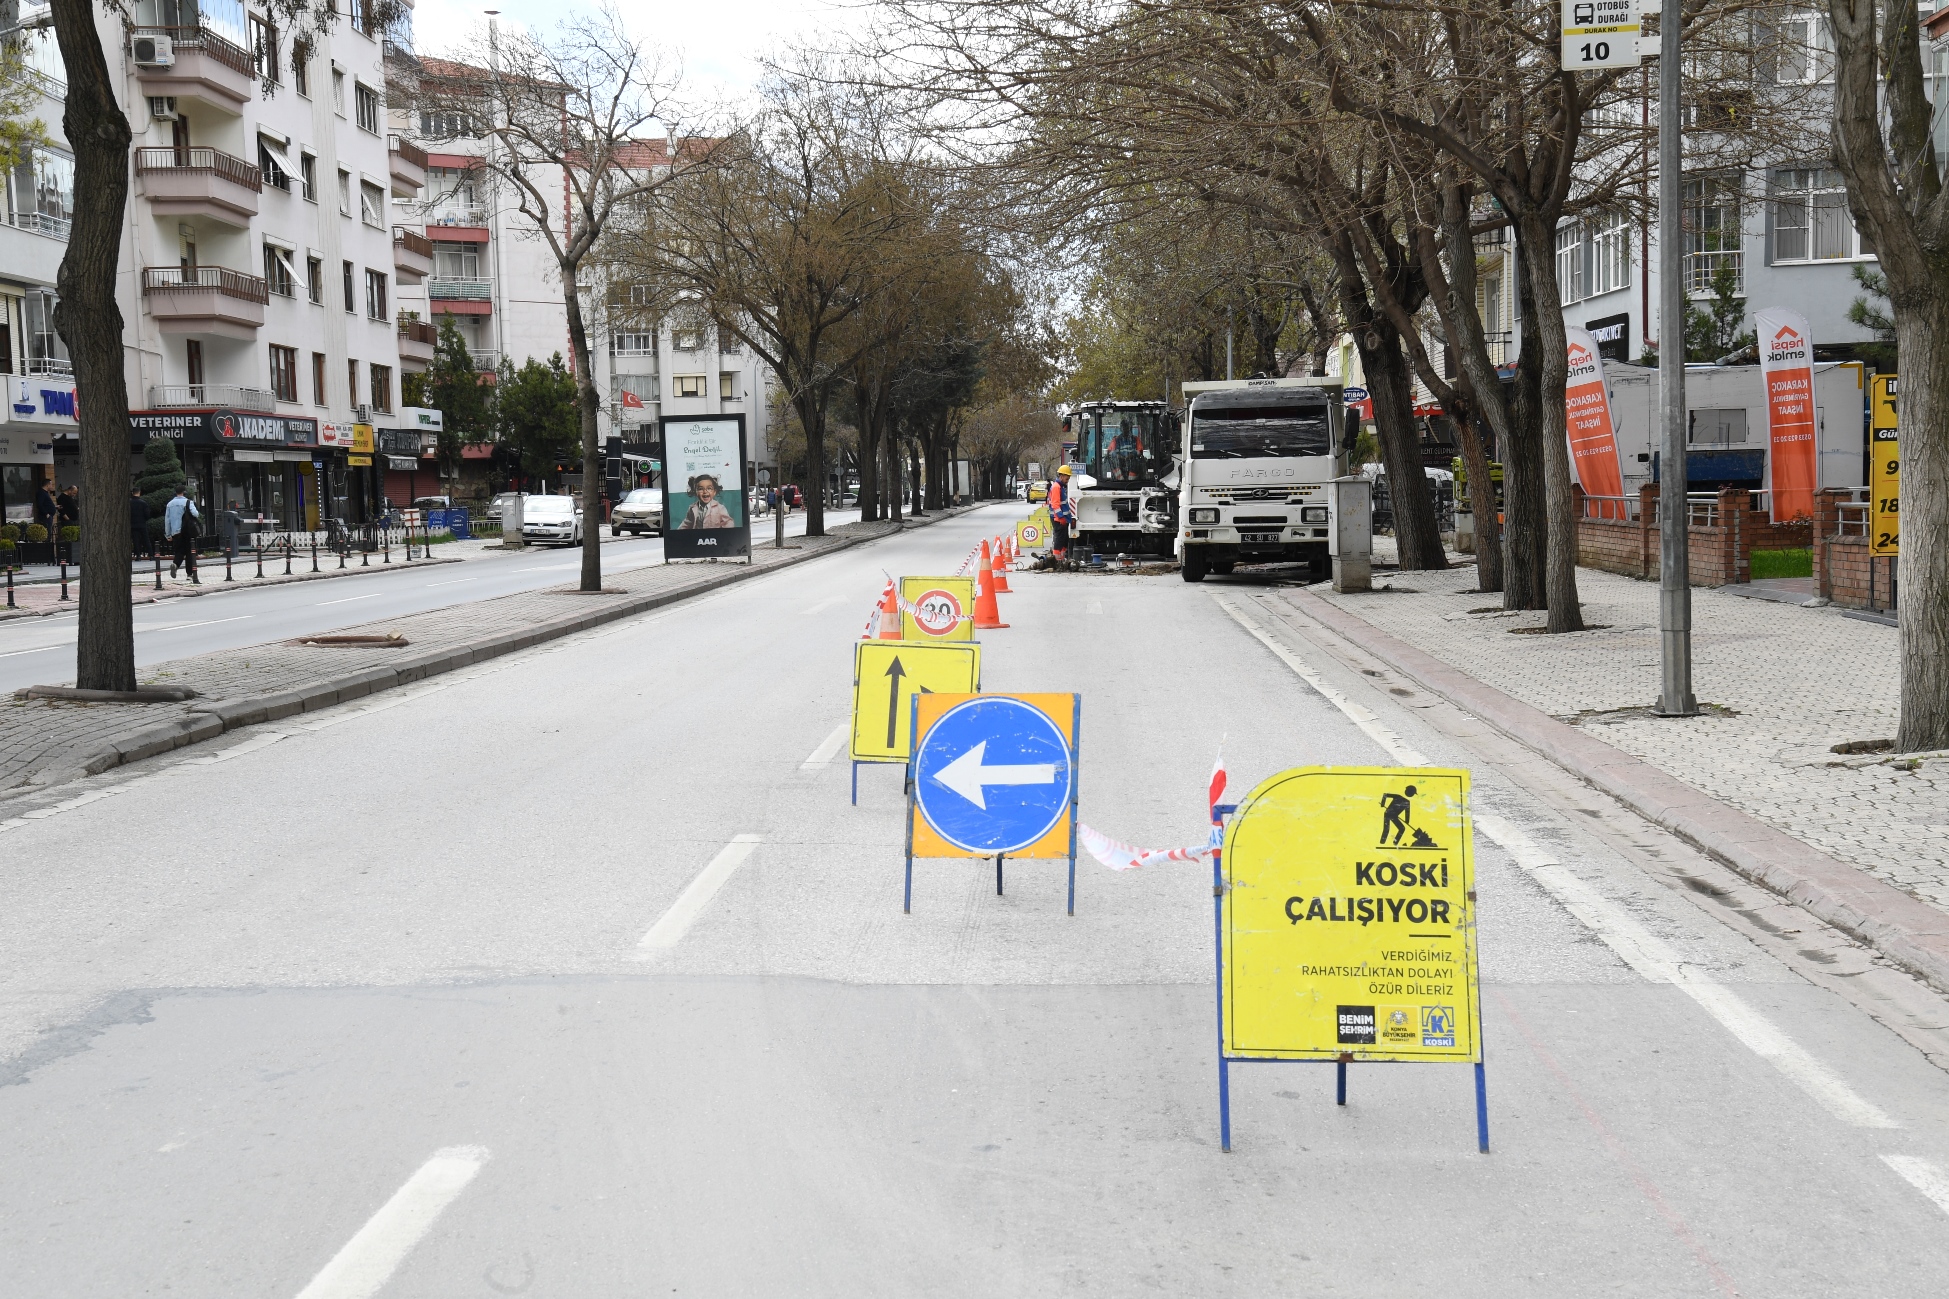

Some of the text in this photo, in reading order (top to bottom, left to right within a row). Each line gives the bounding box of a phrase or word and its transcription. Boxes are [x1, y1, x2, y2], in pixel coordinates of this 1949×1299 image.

[1597, 11, 1629, 24] DURAĞI
[1580, 41, 1610, 62] 10
[130, 416, 202, 428] VETERİNER
[288, 420, 313, 432] VETERİNER
[149, 428, 184, 439] KLİNİĞİ
[237, 417, 285, 440] AKADEMİ
[683, 446, 701, 455] Engel
[1230, 468, 1295, 478] FARGO
[1880, 498, 1899, 513] 18
[1025, 530, 1036, 538] 30
[1355, 858, 1449, 888] KOSKİ
[1284, 896, 1451, 927] ÇALIŞIYOR
[1381, 949, 1453, 962] VERDİĞİMİZ
[1302, 966, 1453, 978] RAHATSIZLIKTAN DOLAYI
[1369, 981, 1454, 995] ÖZÜR DİLERİZ
[1339, 1015, 1374, 1025] BENİM
[1431, 1015, 1444, 1033] K
[1339, 1025, 1374, 1035] ŞEHRİM
[1424, 1038, 1452, 1047] KOSKİ
